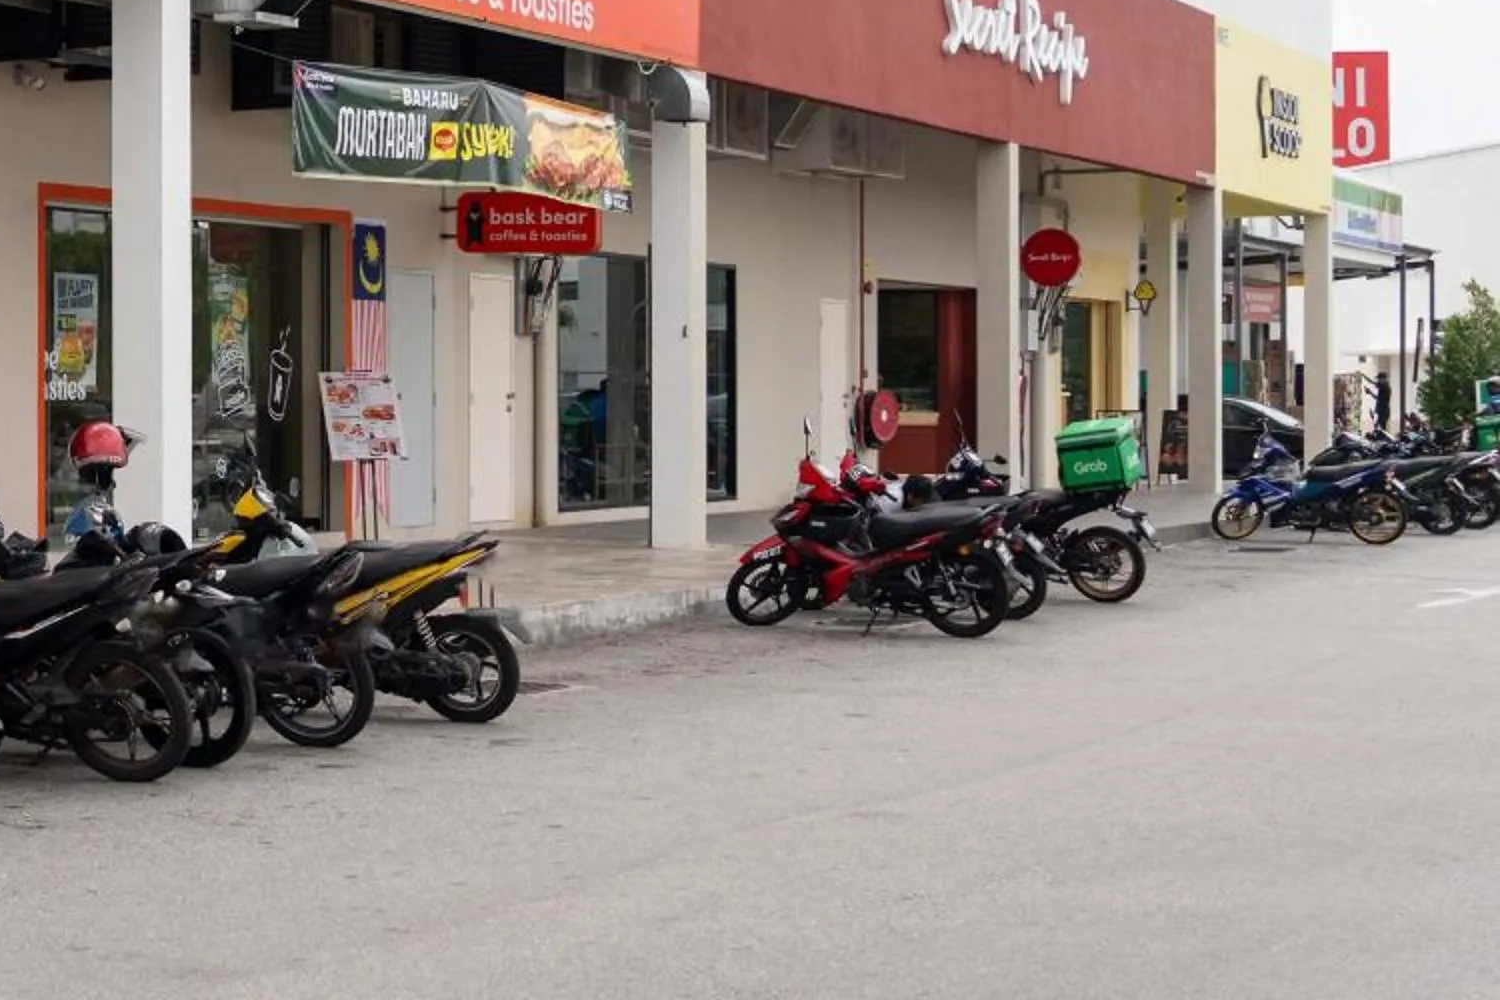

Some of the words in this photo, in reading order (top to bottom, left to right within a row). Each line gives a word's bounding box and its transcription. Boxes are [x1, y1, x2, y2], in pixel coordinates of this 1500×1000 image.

[402, 87, 459, 112] BAHARU
[335, 105, 428, 162] MURTABAK
[489, 208, 535, 226] bask
[541, 207, 589, 226] bear
[489, 230, 527, 242] coffee
[541, 229, 588, 242] toasties
[1073, 459, 1108, 476] Grab
